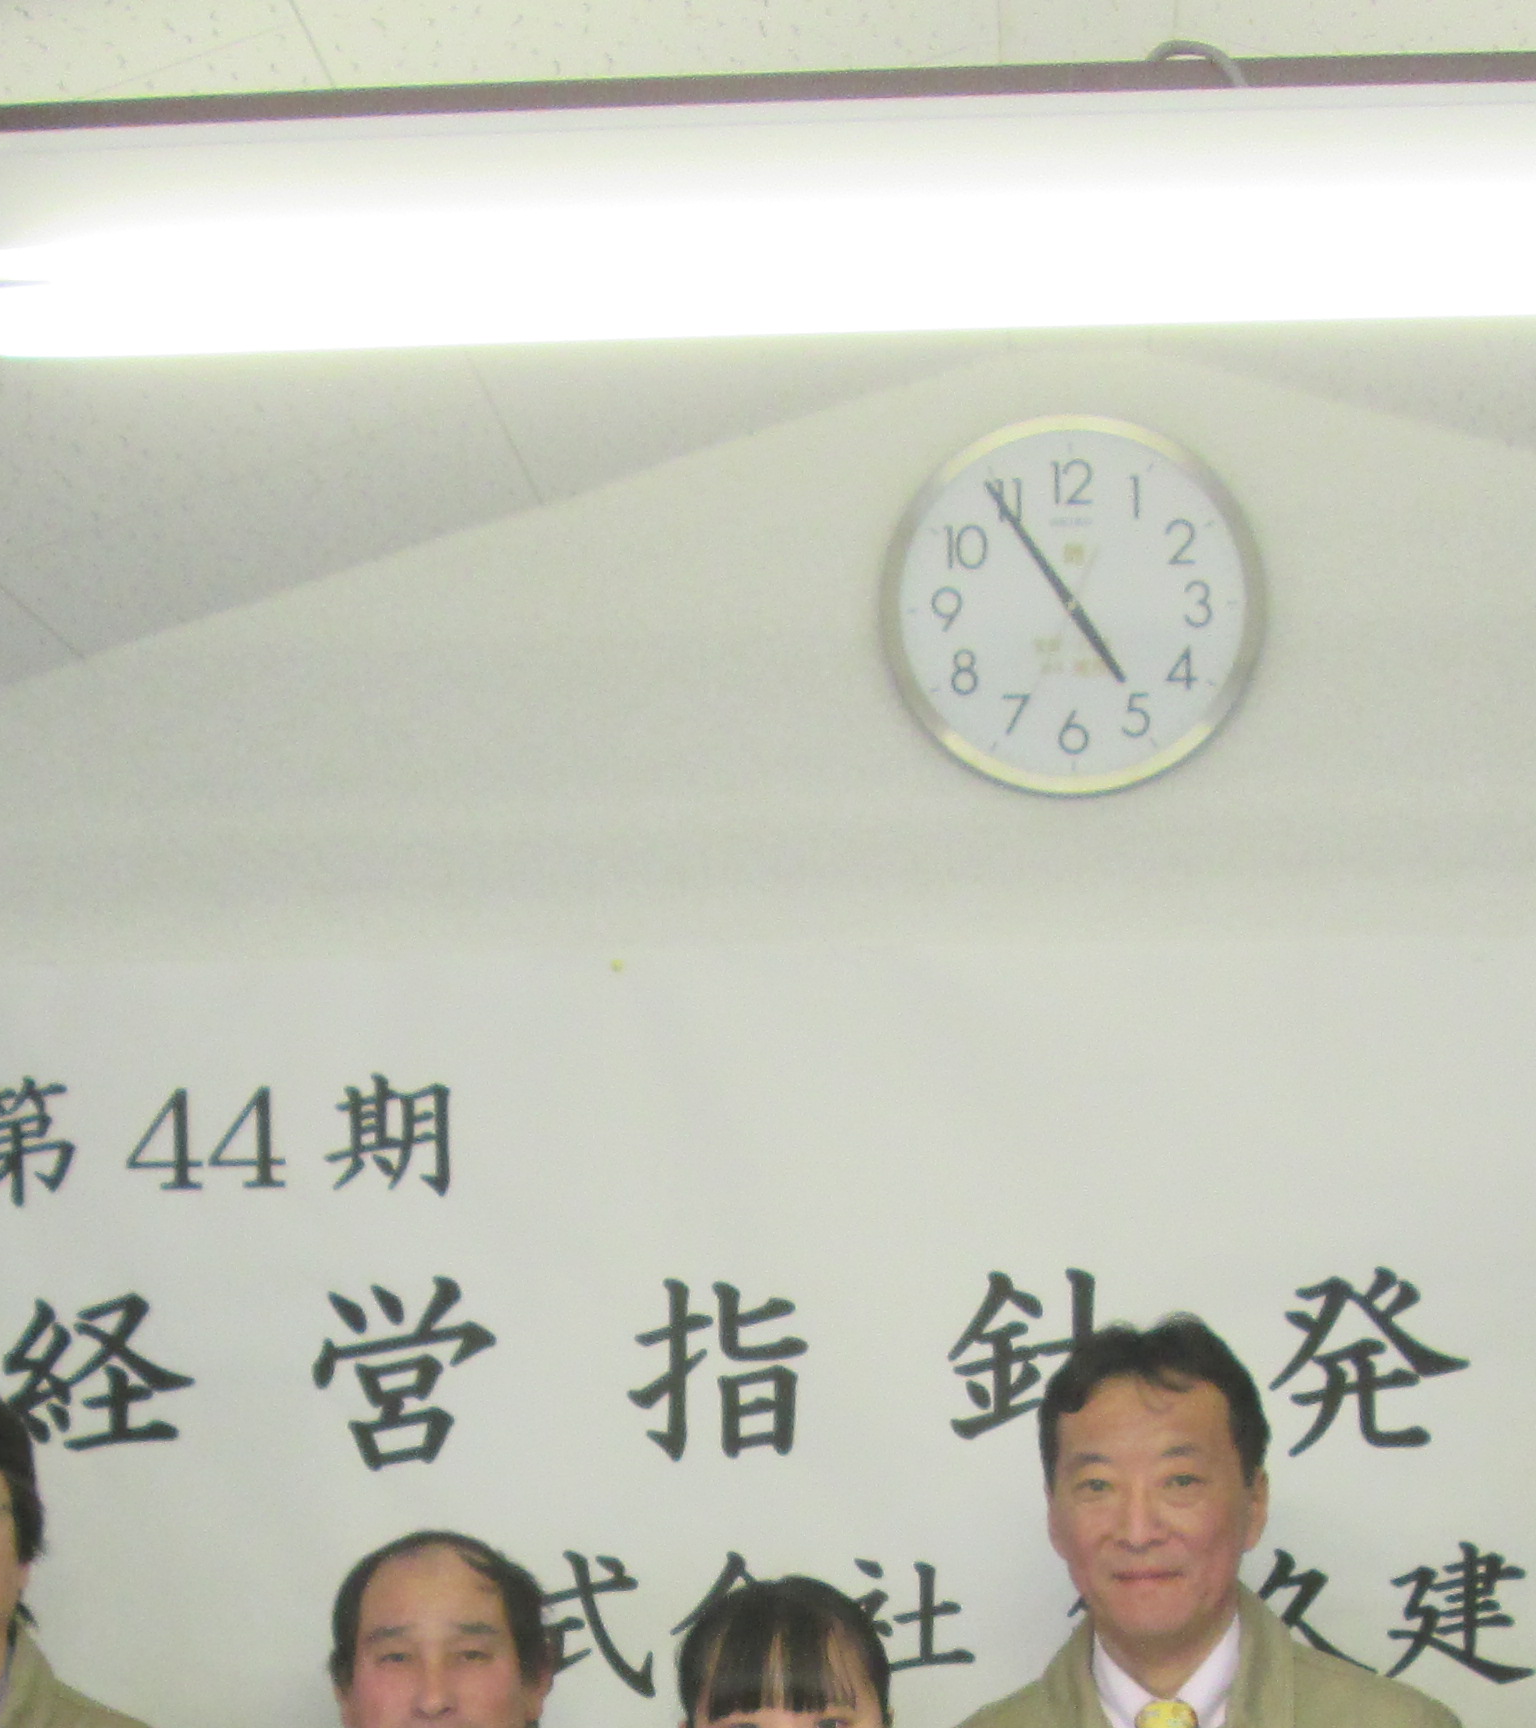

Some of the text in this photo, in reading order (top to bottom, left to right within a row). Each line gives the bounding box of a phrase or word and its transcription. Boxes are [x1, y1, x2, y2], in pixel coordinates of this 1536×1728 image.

[1049, 458, 1094, 505] 12
[1129, 474, 1141, 520] 1
[944, 523, 988, 571] 10
[1164, 517, 1197, 566] 2
[930, 585, 964, 633] 9
[1183, 579, 1214, 628] 3
[950, 648, 979, 696] 8
[1165, 645, 1199, 691] 4
[1001, 692, 1032, 735] 7
[1057, 709, 1091, 756] 6
[1121, 692, 1152, 738] 5
